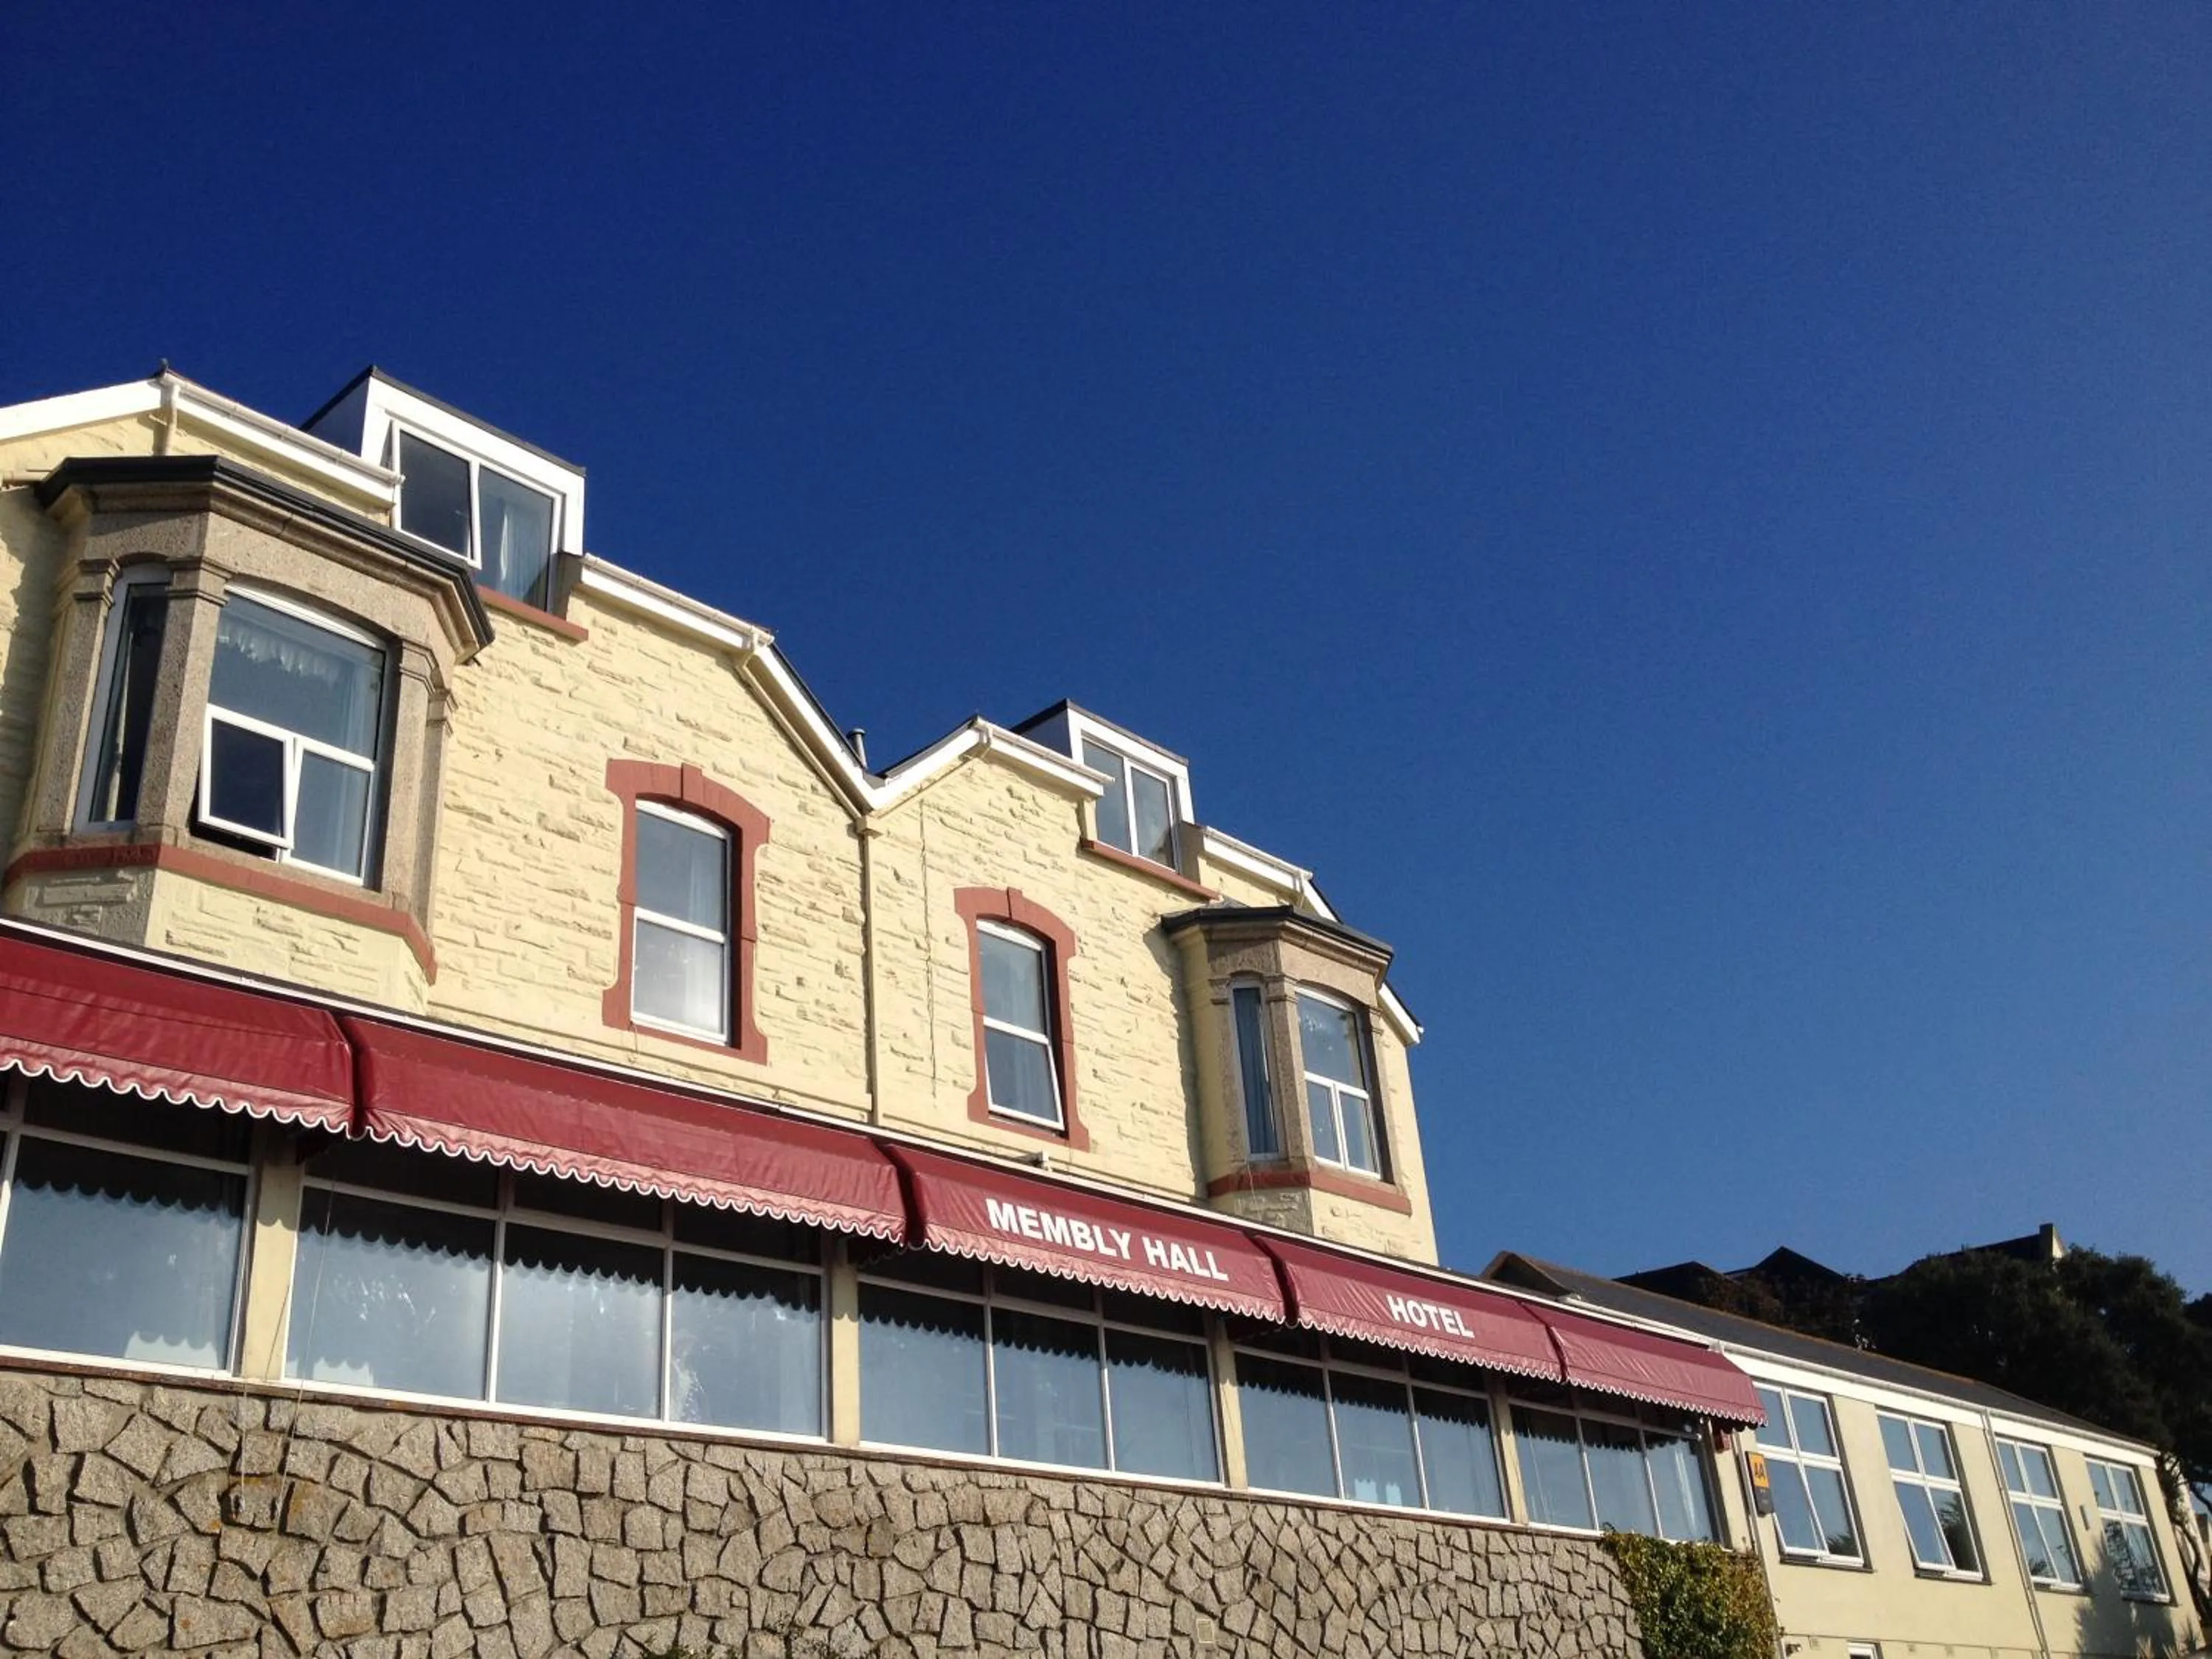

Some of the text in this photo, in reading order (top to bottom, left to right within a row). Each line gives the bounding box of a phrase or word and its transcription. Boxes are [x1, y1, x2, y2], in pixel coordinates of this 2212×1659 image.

[985, 1197, 1475, 1339] MEMBLY HALL HOTEL
